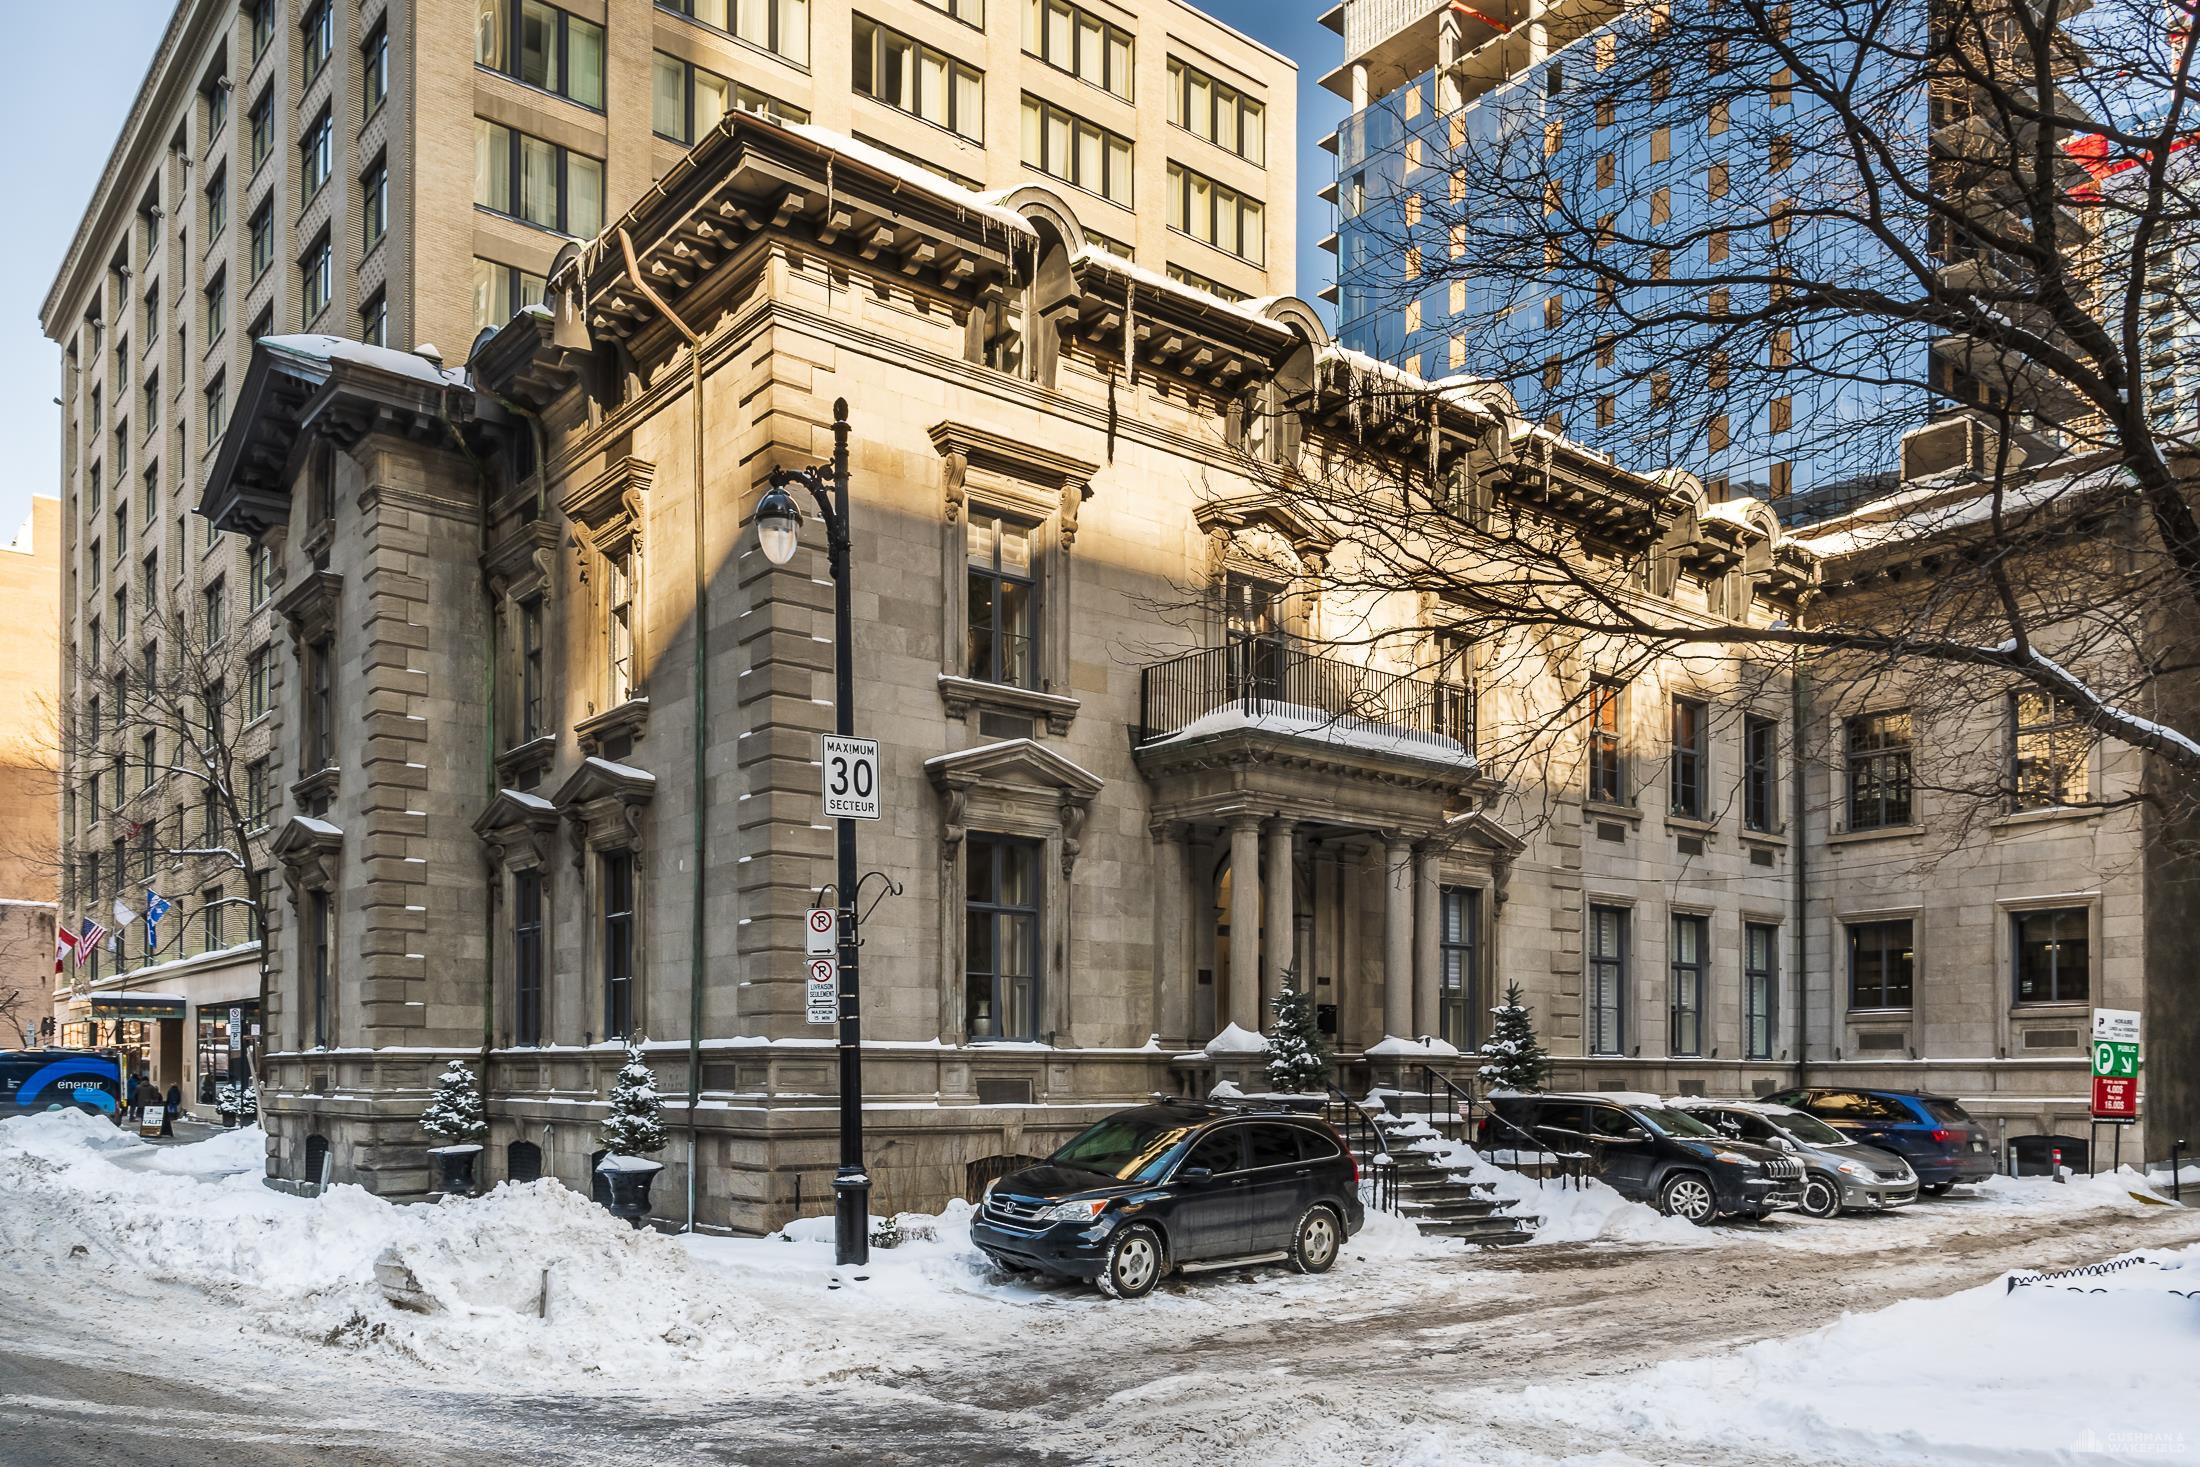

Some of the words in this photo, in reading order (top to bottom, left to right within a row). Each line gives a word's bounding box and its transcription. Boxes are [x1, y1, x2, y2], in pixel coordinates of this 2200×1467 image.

[827, 741, 875, 756] MAXIMUM
[830, 756, 873, 798] 30
[829, 799, 875, 812] SECTEUR
[2117, 1045, 2136, 1053] PUBLIC
